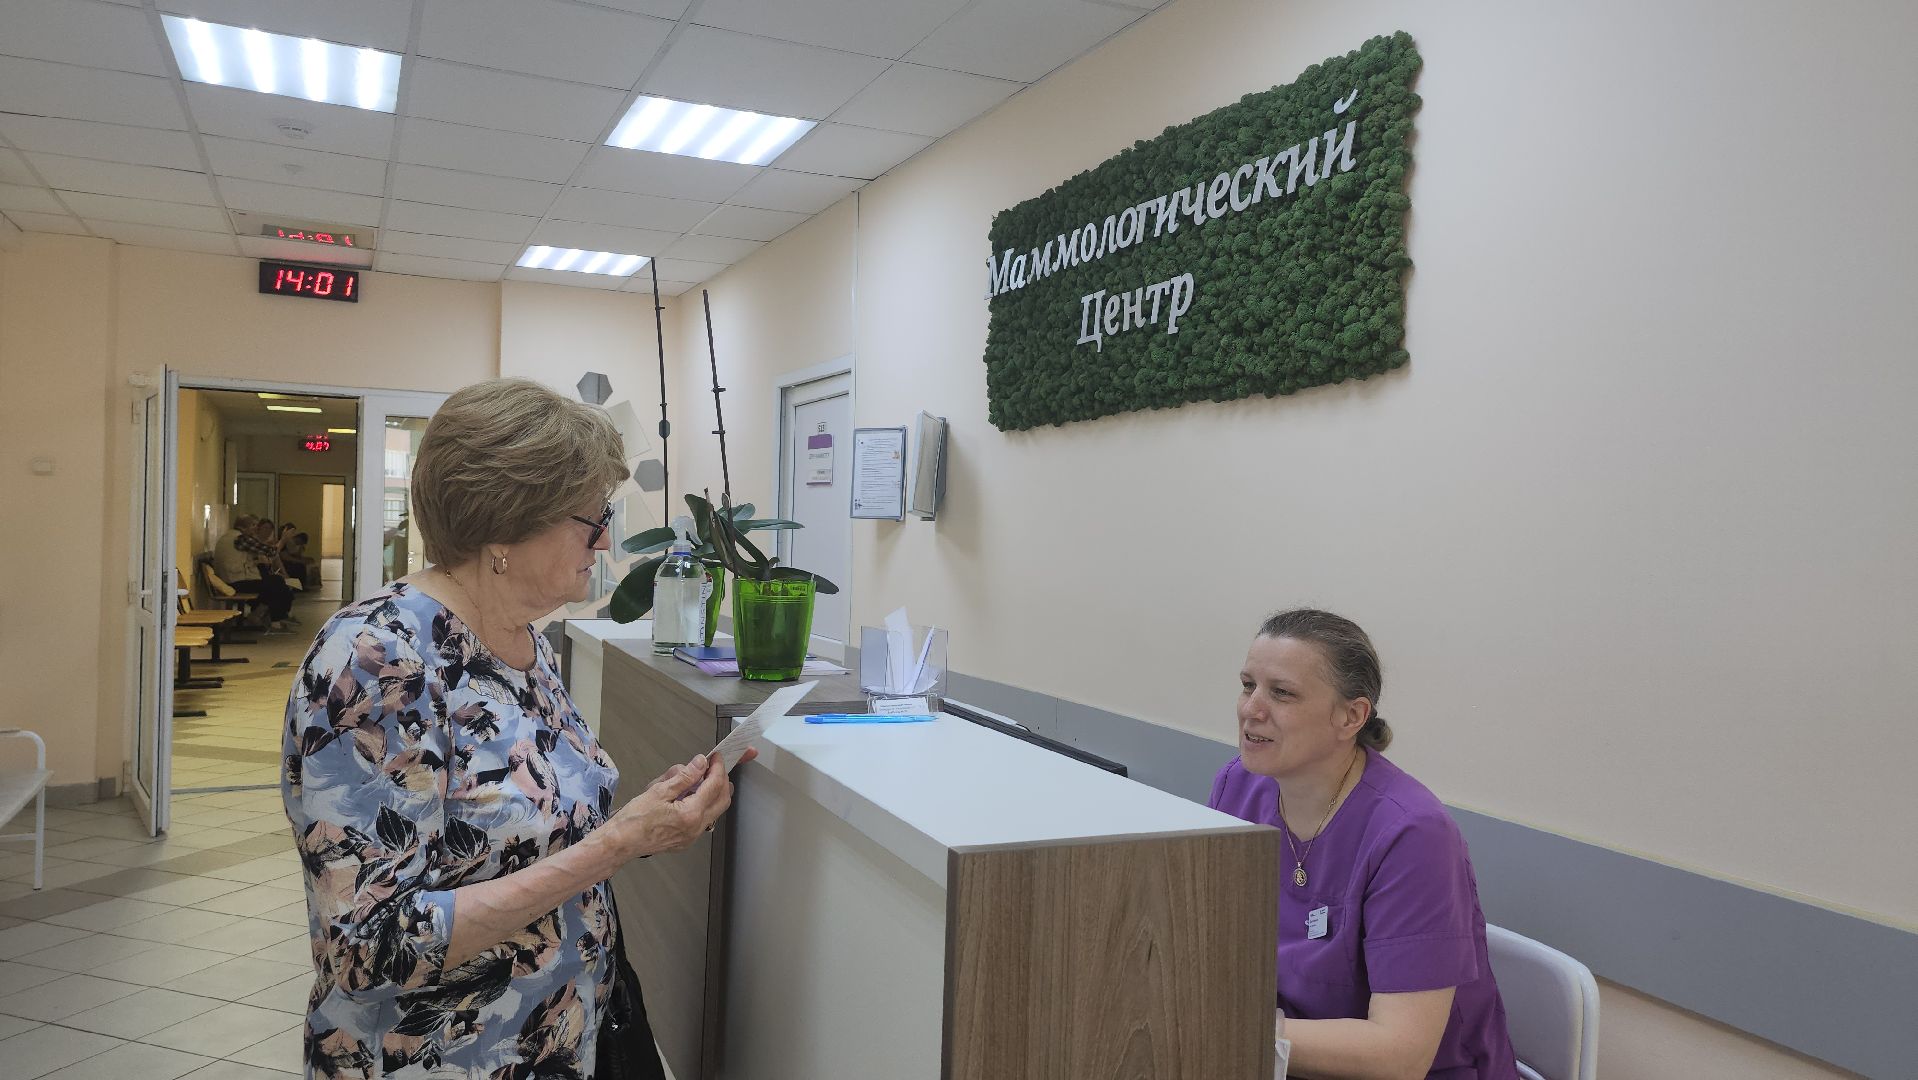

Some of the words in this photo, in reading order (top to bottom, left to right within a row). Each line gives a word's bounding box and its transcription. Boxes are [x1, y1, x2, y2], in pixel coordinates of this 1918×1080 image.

[984, 89, 1358, 299] Маммологический
[274, 269, 354, 297] 14:01
[1077, 272, 1194, 353] Центр
